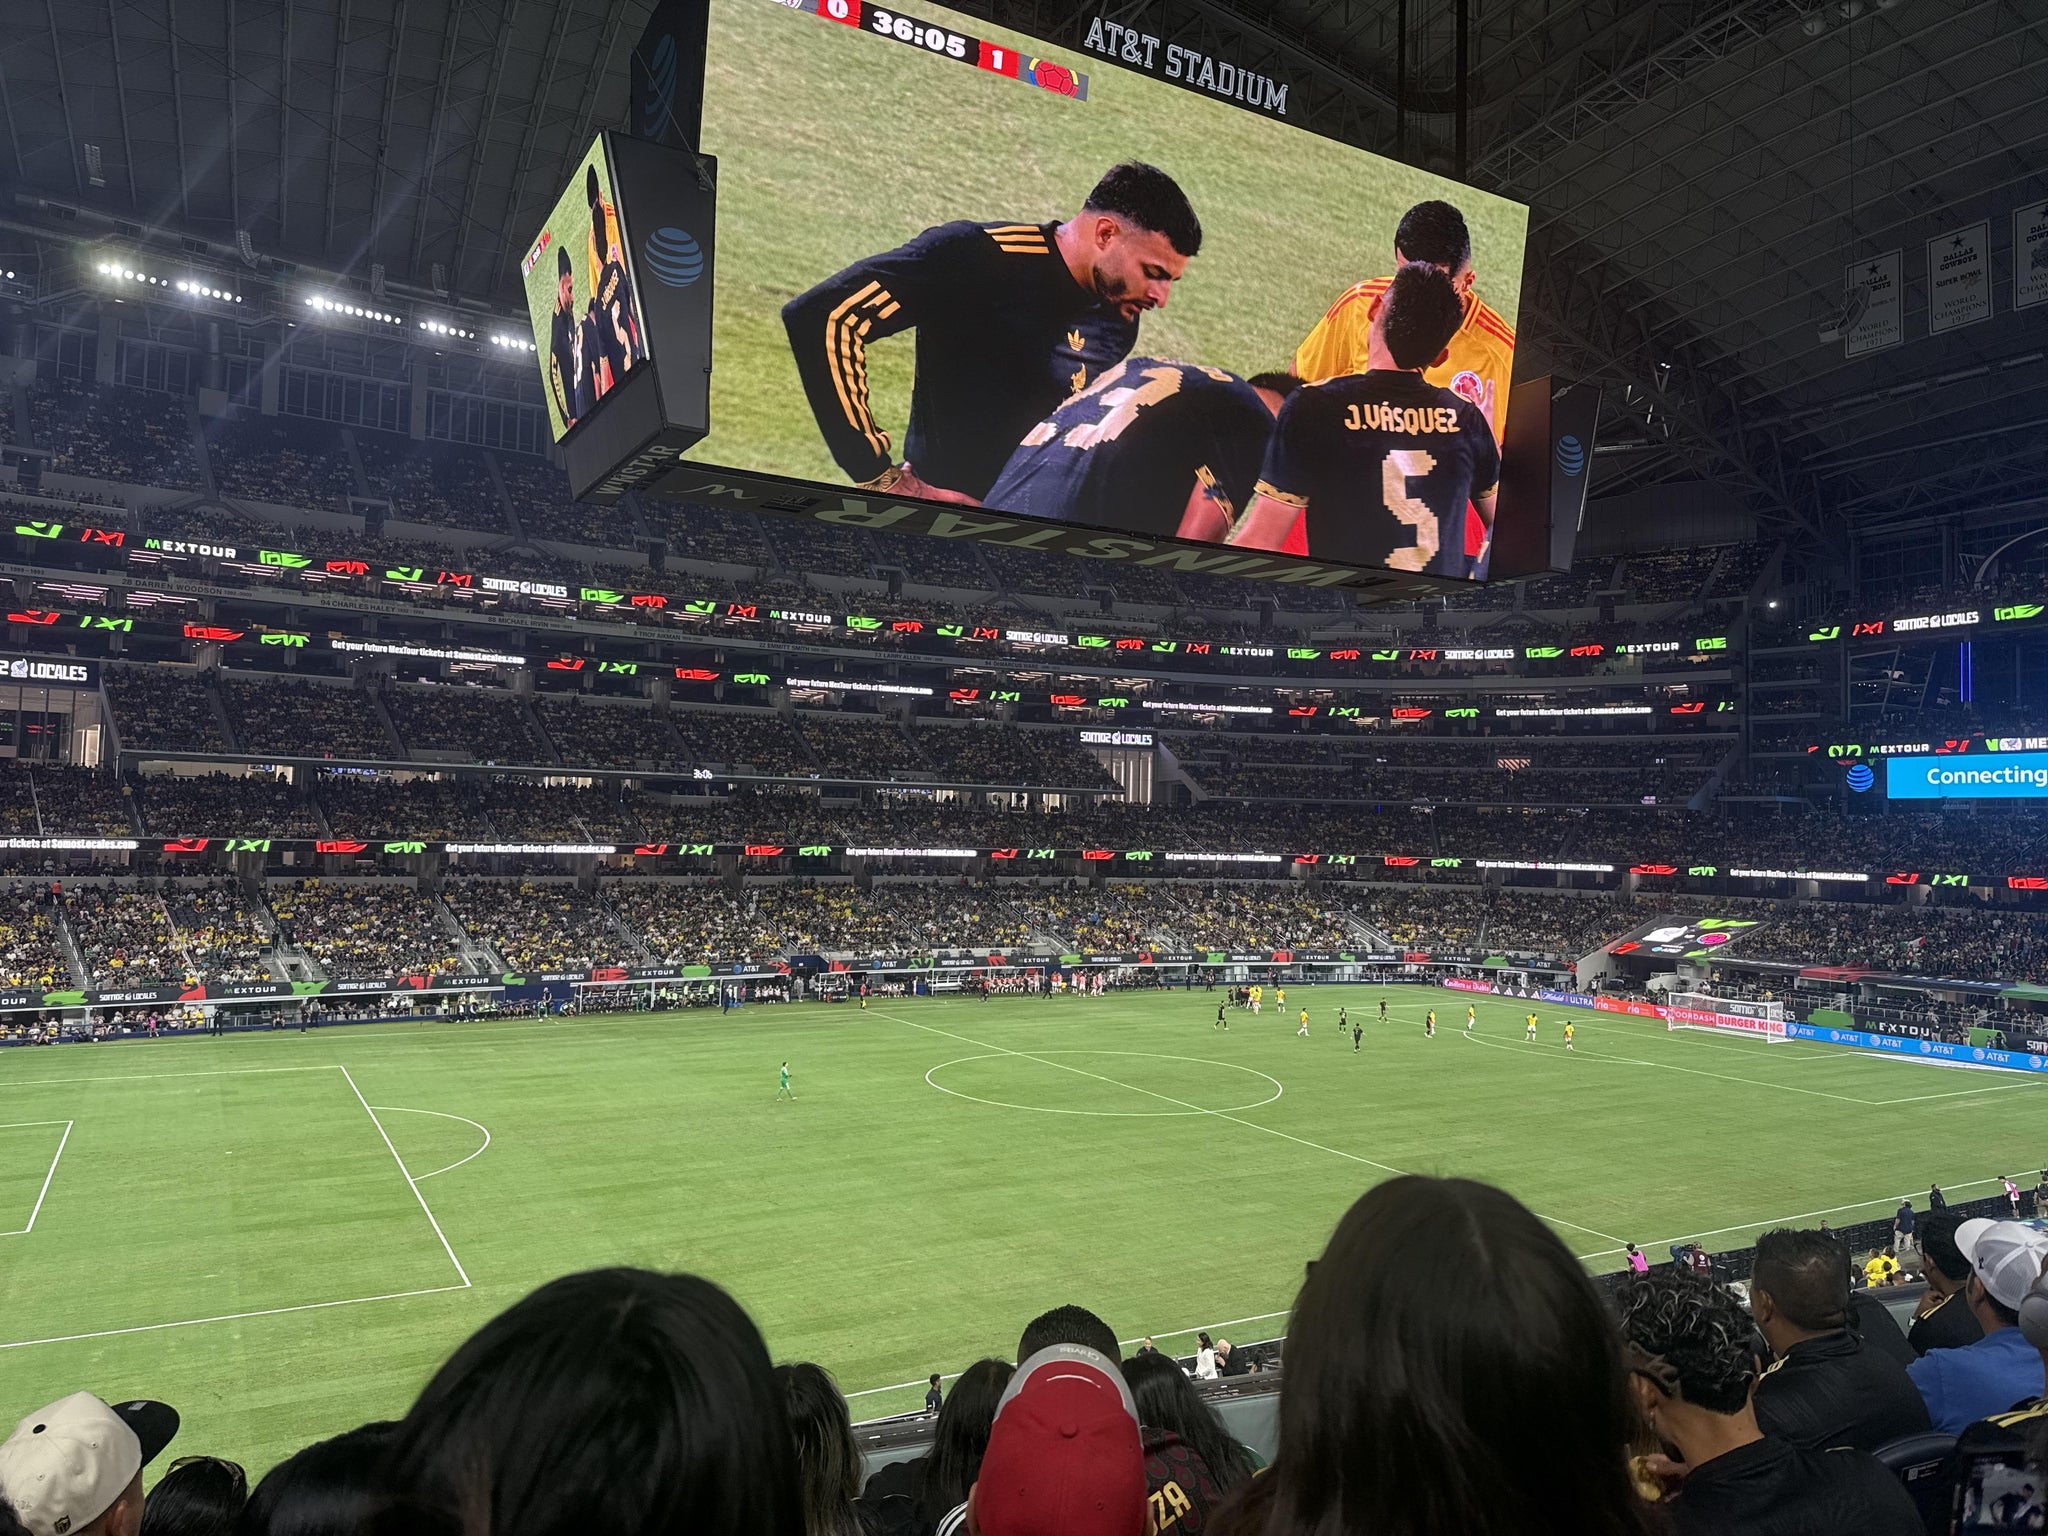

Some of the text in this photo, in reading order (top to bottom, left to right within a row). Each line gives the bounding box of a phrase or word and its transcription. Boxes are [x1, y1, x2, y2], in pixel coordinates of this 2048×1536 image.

[827, 0, 1003, 70] 0 36:05 1
[1084, 16, 1288, 115] AT&T STADIUM
[1943, 247, 1974, 262] DALLAS
[1940, 254, 1978, 271] COWBOYS
[1935, 269, 1983, 289] SUPER BOWL
[1944, 295, 1977, 308] WORLD
[1934, 301, 1987, 320] CHAMPIONS
[1859, 320, 1888, 331] WORLD
[1850, 325, 1898, 344] CHAMPIONS
[596, 445, 680, 495] WINSTAR
[1382, 450, 1439, 572] 5
[145, 538, 236, 559] MEXTOUR
[813, 499, 1357, 589] WINSTAR
[135, 579, 173, 590] DARREN
[176, 584, 222, 595] WOODSON
[332, 600, 369, 610] CHARLES
[370, 604, 396, 613] HALEY
[769, 609, 831, 624] MEXTOUR
[332, 640, 526, 664] Get your future MexTour tickets at SomosLocales.com
[1220, 646, 1273, 657] MEXTOUR
[1615, 642, 1679, 654] MEXTOUR
[30, 662, 87, 682] LOCALES
[797, 679, 810, 688] your
[811, 679, 828, 688] future
[829, 680, 851, 689] MexTour
[852, 682, 871, 691] tickets
[1869, 744, 1929, 754] MEXTOUR
[1927, 765, 2048, 787] Connecting
[10, 838, 40, 849] tickets
[41, 839, 51, 849] at
[635, 969, 674, 977] MEXTOUR
[743, 964, 760, 972] AT&T
[224, 987, 277, 995] MEXTOUR
[1570, 996, 1593, 1006] ULTRA
[1597, 999, 1608, 1009] ria
[1627, 1003, 1639, 1014] ria
[1674, 1009, 1715, 1022] OORDASH
[1718, 1014, 1783, 1033] BURGER KING
[1865, 1020, 1930, 1036] MEXTOU
[1798, 1028, 1815, 1036] AT&T
[1840, 1033, 1858, 1042] AT&T
[1882, 1038, 1903, 1048] AT&T
[1932, 1045, 1955, 1055] AT&T
[1986, 1052, 2010, 1063] AT&T
